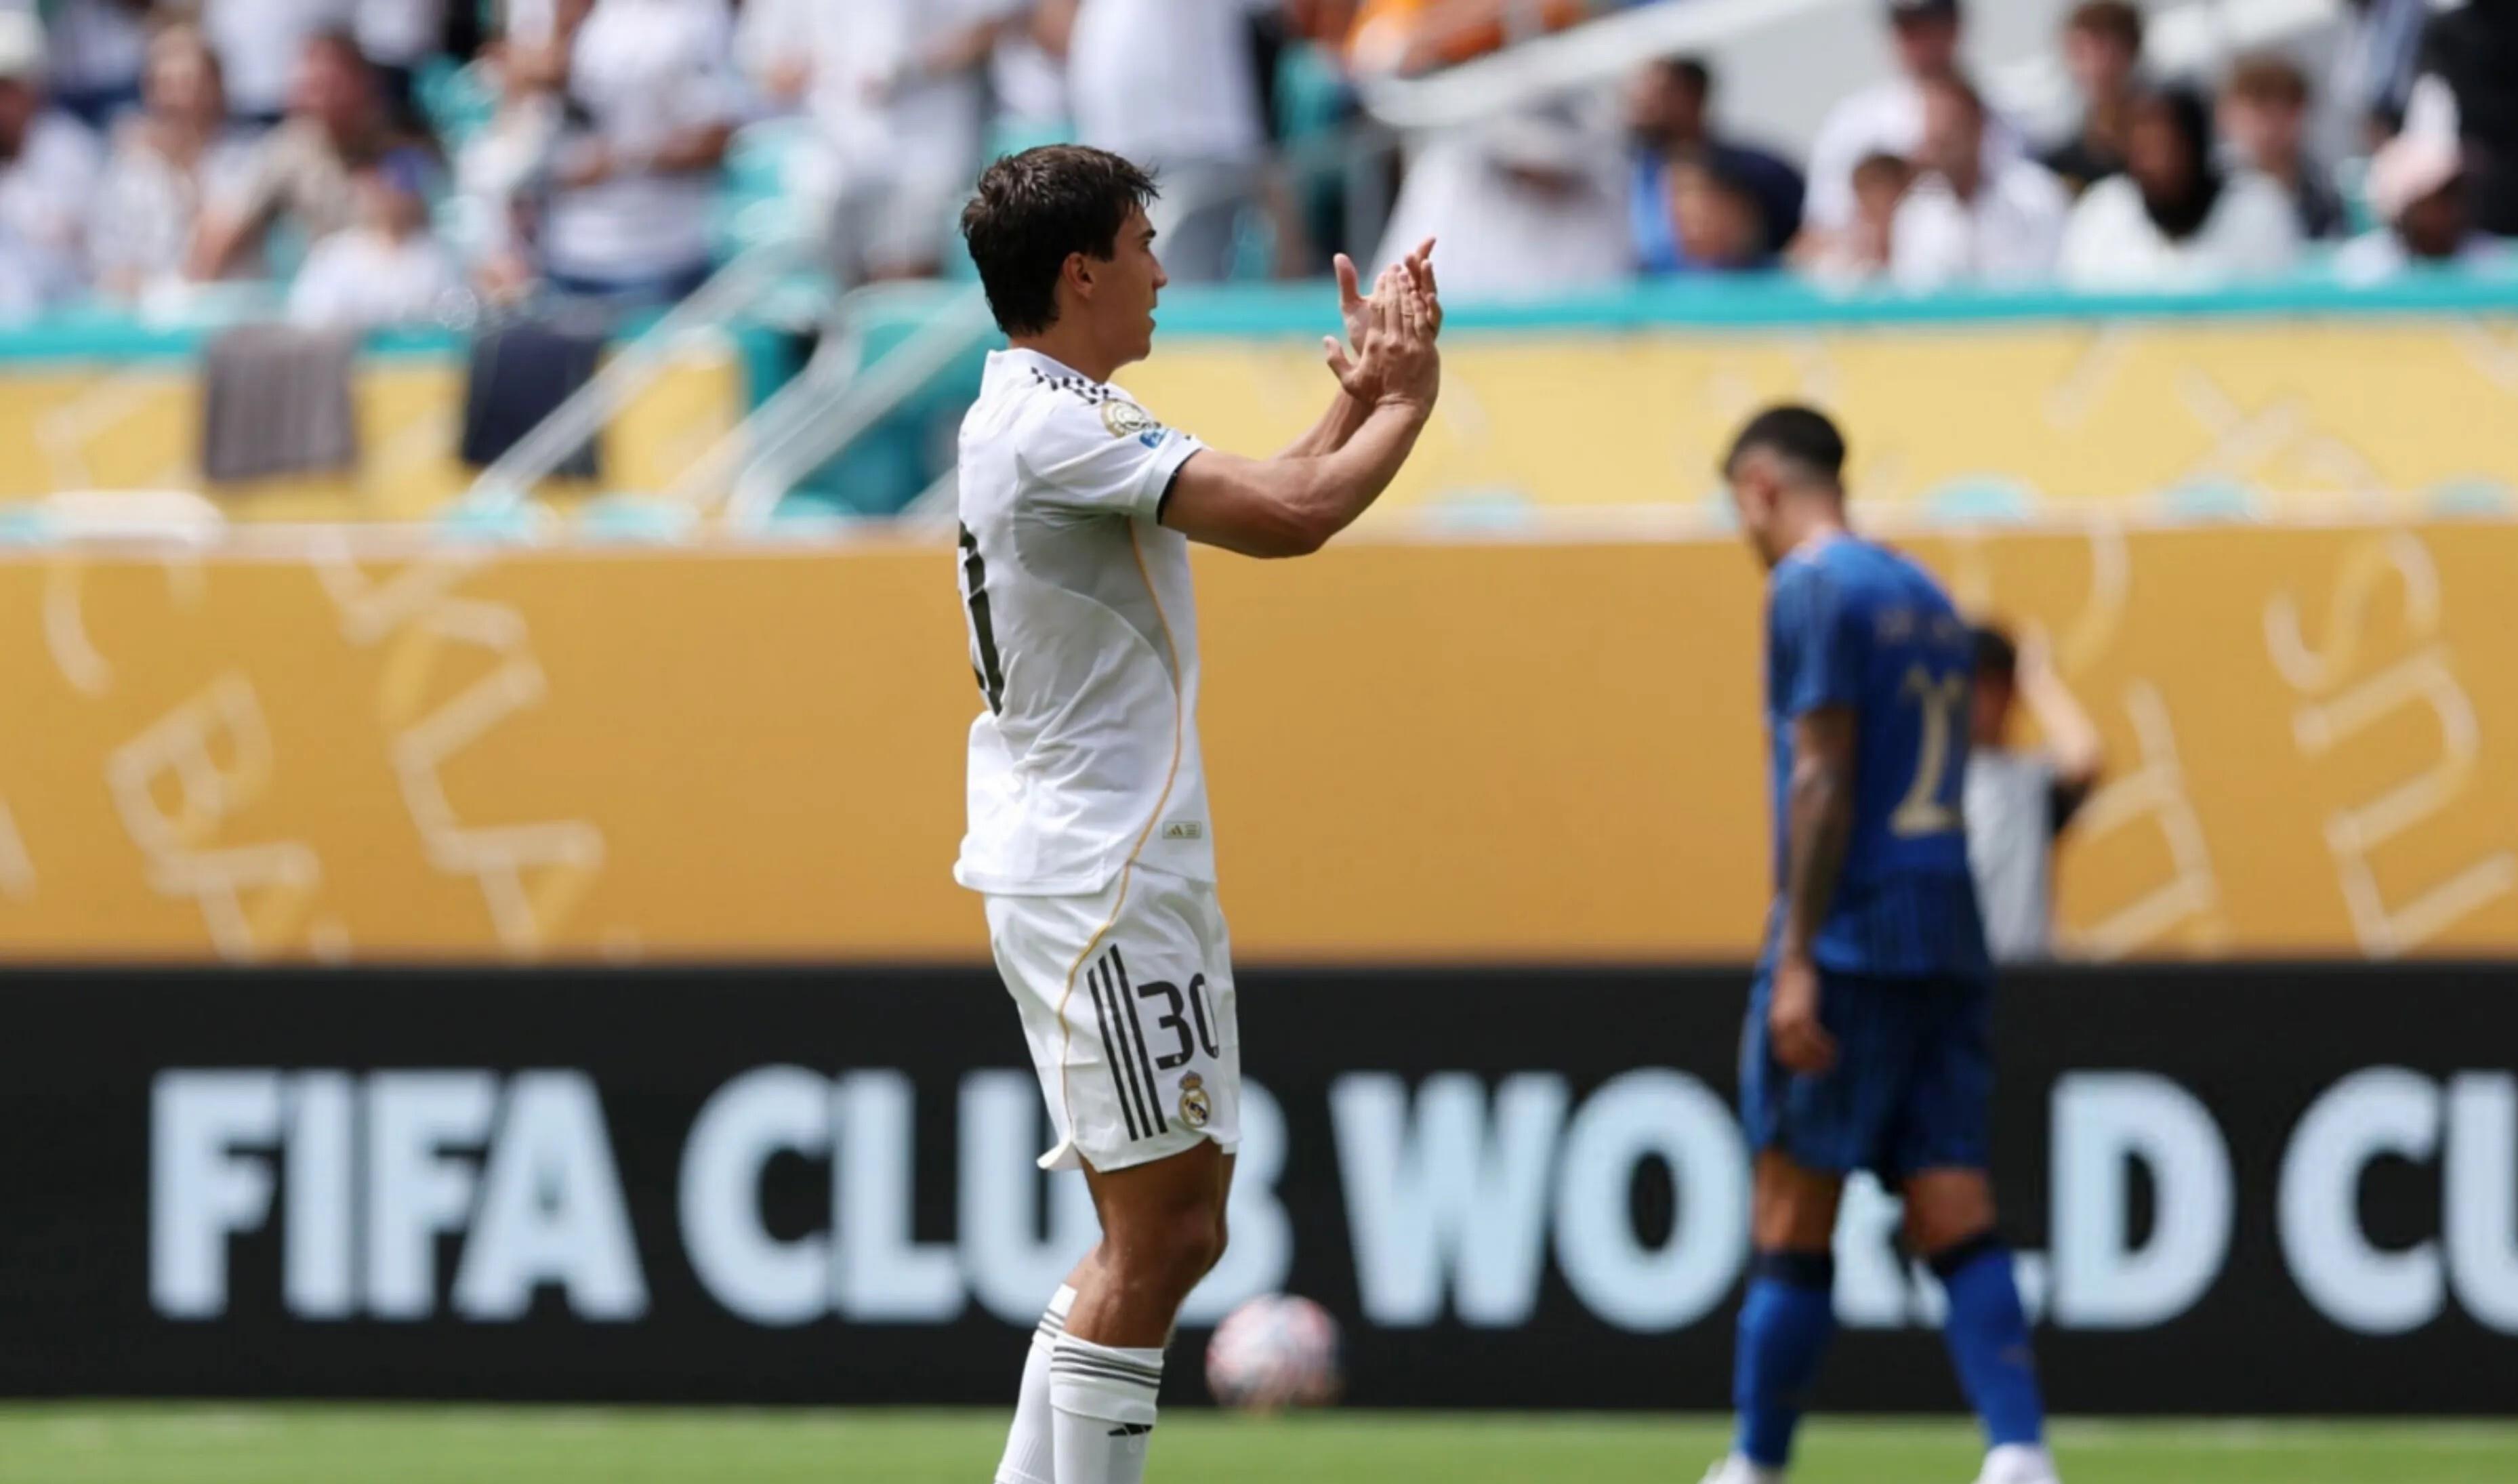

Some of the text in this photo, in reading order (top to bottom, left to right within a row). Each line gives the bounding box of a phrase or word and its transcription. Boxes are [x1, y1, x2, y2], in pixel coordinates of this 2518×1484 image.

[1138, 972, 1220, 1071] 30
[150, 1068, 650, 1320] FIFA
[1328, 1066, 2234, 1332] WOD
